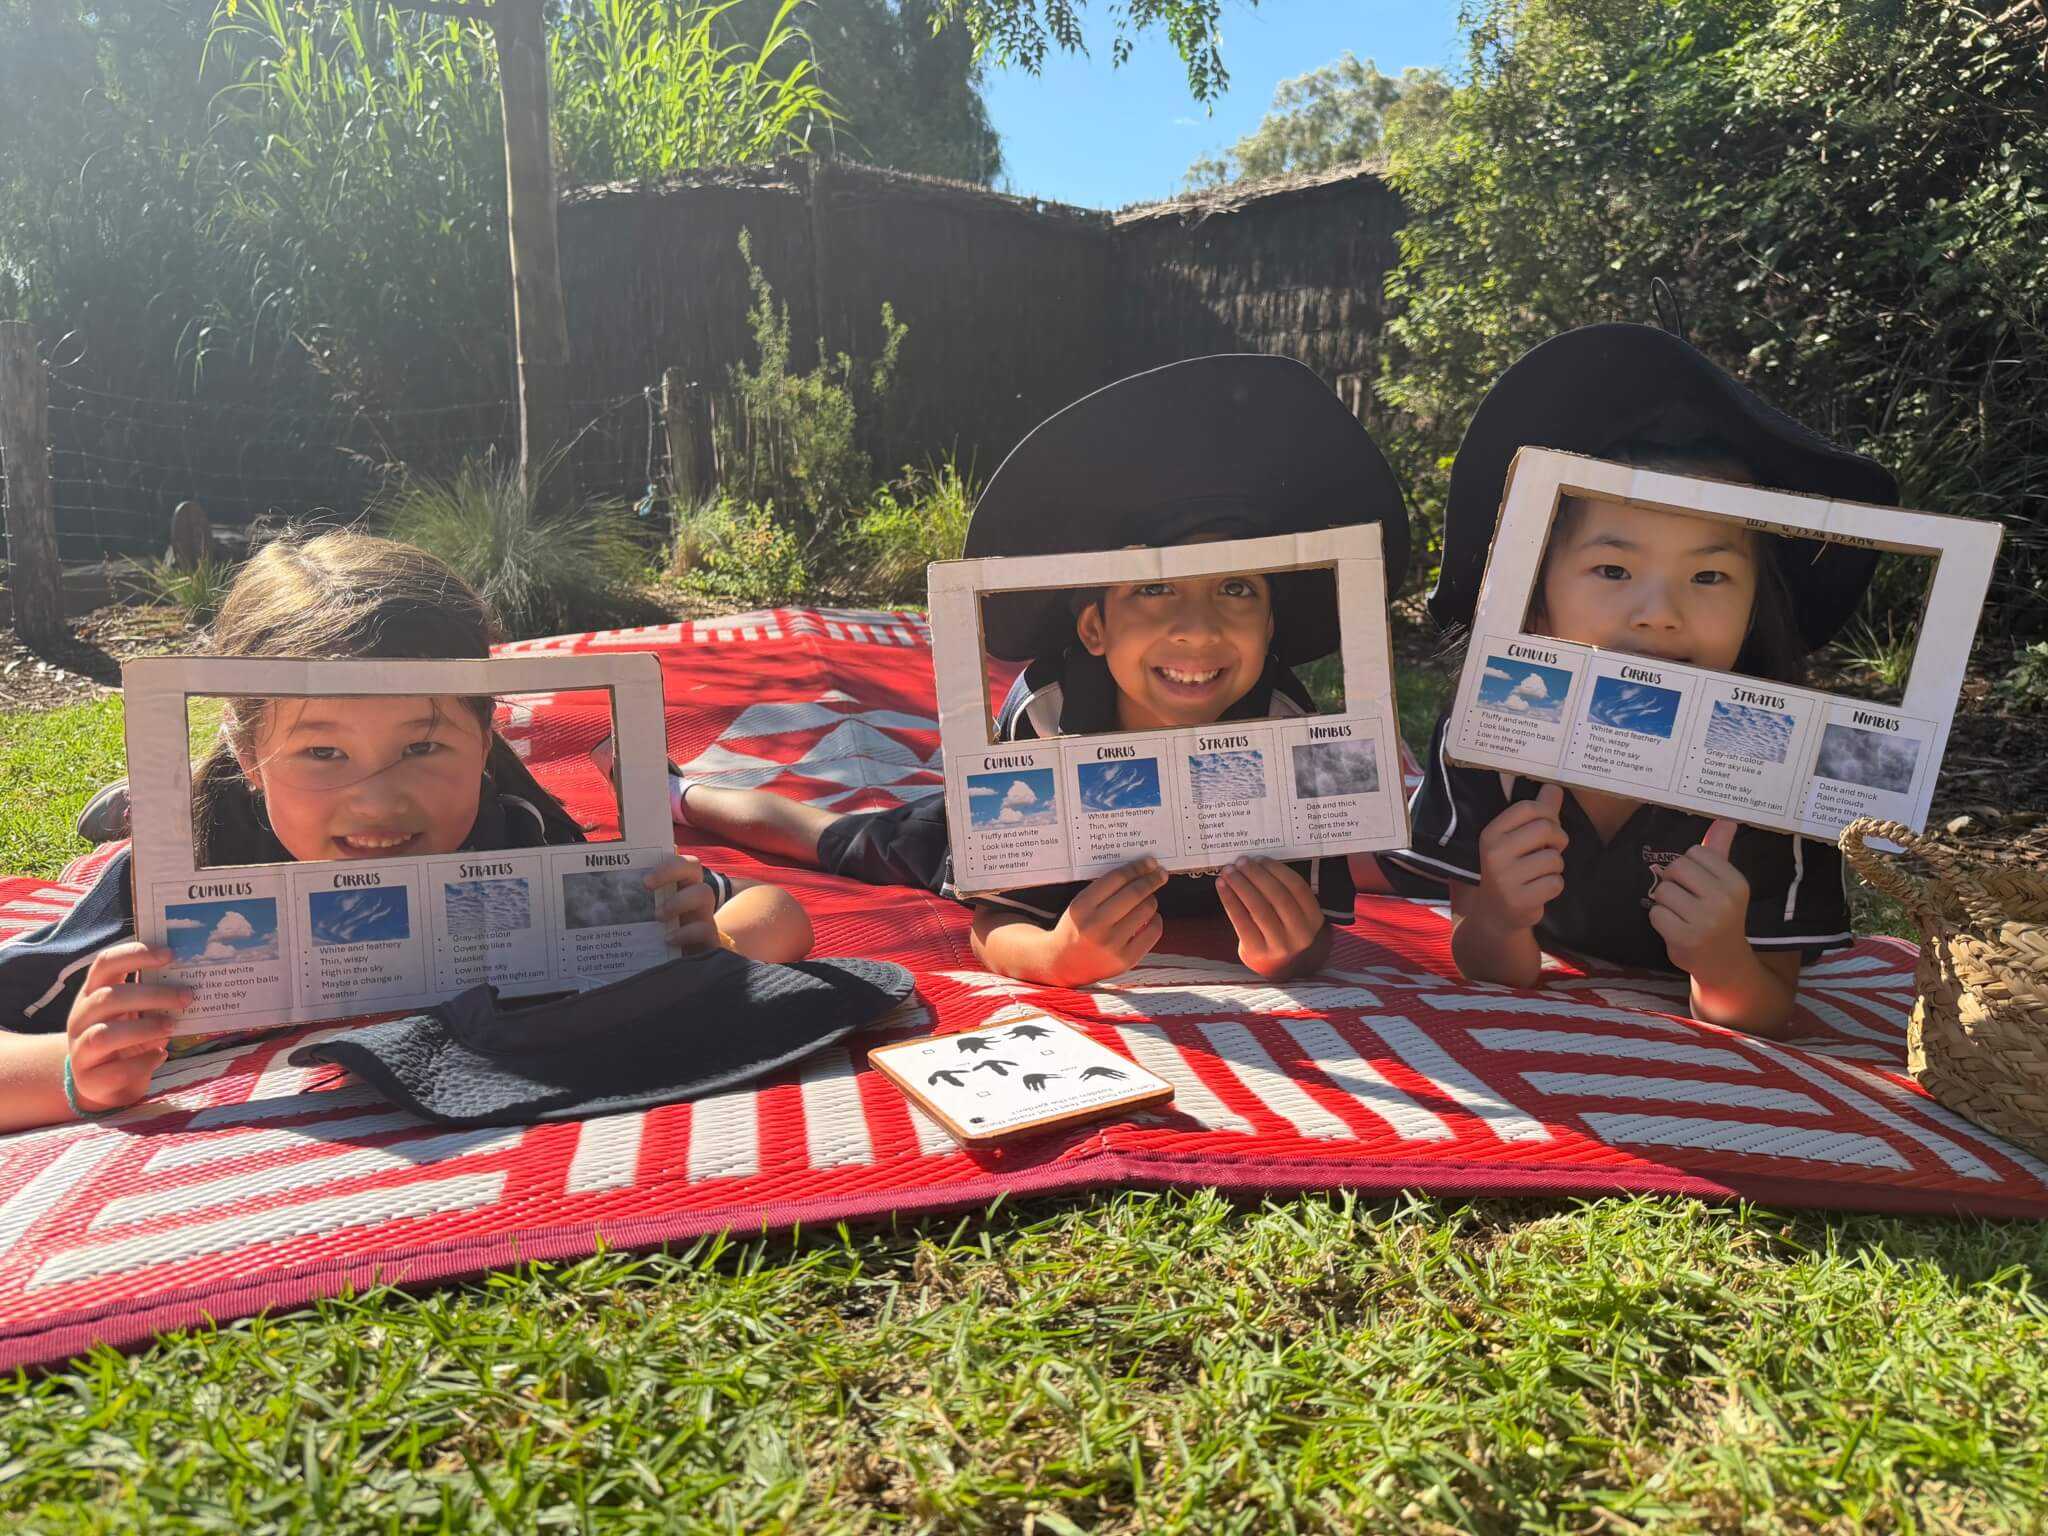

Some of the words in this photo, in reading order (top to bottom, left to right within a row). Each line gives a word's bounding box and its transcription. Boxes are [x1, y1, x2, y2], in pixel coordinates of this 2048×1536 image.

[1507, 643, 1557, 664] CUMULUS
[1620, 665, 1662, 684] CIRRUS
[1731, 687, 1785, 709] STRATUS
[1481, 712, 1501, 722] Fluffy
[1503, 716, 1517, 724] and
[1518, 719, 1538, 728] white
[1852, 710, 1899, 731] NIMBUS
[1309, 724, 1351, 739] NIMBUS
[1477, 730, 1492, 738] Low
[1501, 735, 1513, 743] the
[1514, 738, 1527, 746] sky
[1479, 721, 1496, 729] Look
[1512, 728, 1536, 737] cotton
[1536, 732, 1554, 741] balls
[1591, 724, 1613, 734] White
[1630, 732, 1661, 745] feathery
[1198, 735, 1248, 750] STRATUS
[1489, 743, 1519, 753] weather
[1588, 733, 1607, 743] Thin,
[1608, 738, 1630, 748] wispy
[1096, 745, 1135, 759] CIRRUS
[1586, 743, 1604, 752] High
[1613, 748, 1626, 756] the
[1627, 751, 1640, 760] sky
[983, 754, 1033, 770] CUMULUS
[1581, 763, 1612, 773] weather
[1583, 752, 1608, 763] Maybe
[1615, 759, 1644, 771] change
[1703, 757, 1725, 767] Cover
[1726, 763, 1741, 772] sky
[1741, 765, 1755, 774] like
[1739, 755, 1764, 765] colour
[1701, 767, 1729, 778] blanket
[1699, 777, 1715, 785] Low
[1725, 782, 1737, 790] the
[1738, 785, 1752, 794] sky
[1818, 782, 1838, 792] Dark
[1838, 787, 1856, 795] and
[1856, 790, 1878, 800] thick
[1696, 786, 1731, 799] Overcast
[1731, 794, 1749, 803] with
[1748, 797, 1767, 808] light
[1767, 801, 1783, 810] rain
[1816, 792, 1835, 802] Rain
[1835, 797, 1864, 808] clouds
[1811, 811, 1827, 820] Full
[1813, 801, 1842, 813] Covers
[1843, 808, 1858, 817] the
[981, 832, 1001, 841] Fluffy
[1018, 829, 1038, 837] white
[1015, 839, 1039, 847] cotton
[1040, 837, 1058, 845] balls
[585, 853, 630, 867] NIMBUS
[1021, 850, 1033, 858] sky
[459, 862, 512, 877] STRATUS
[998, 861, 1028, 869] weather
[333, 871, 380, 887] CIRRUS
[187, 881, 252, 898] CUMULUS
